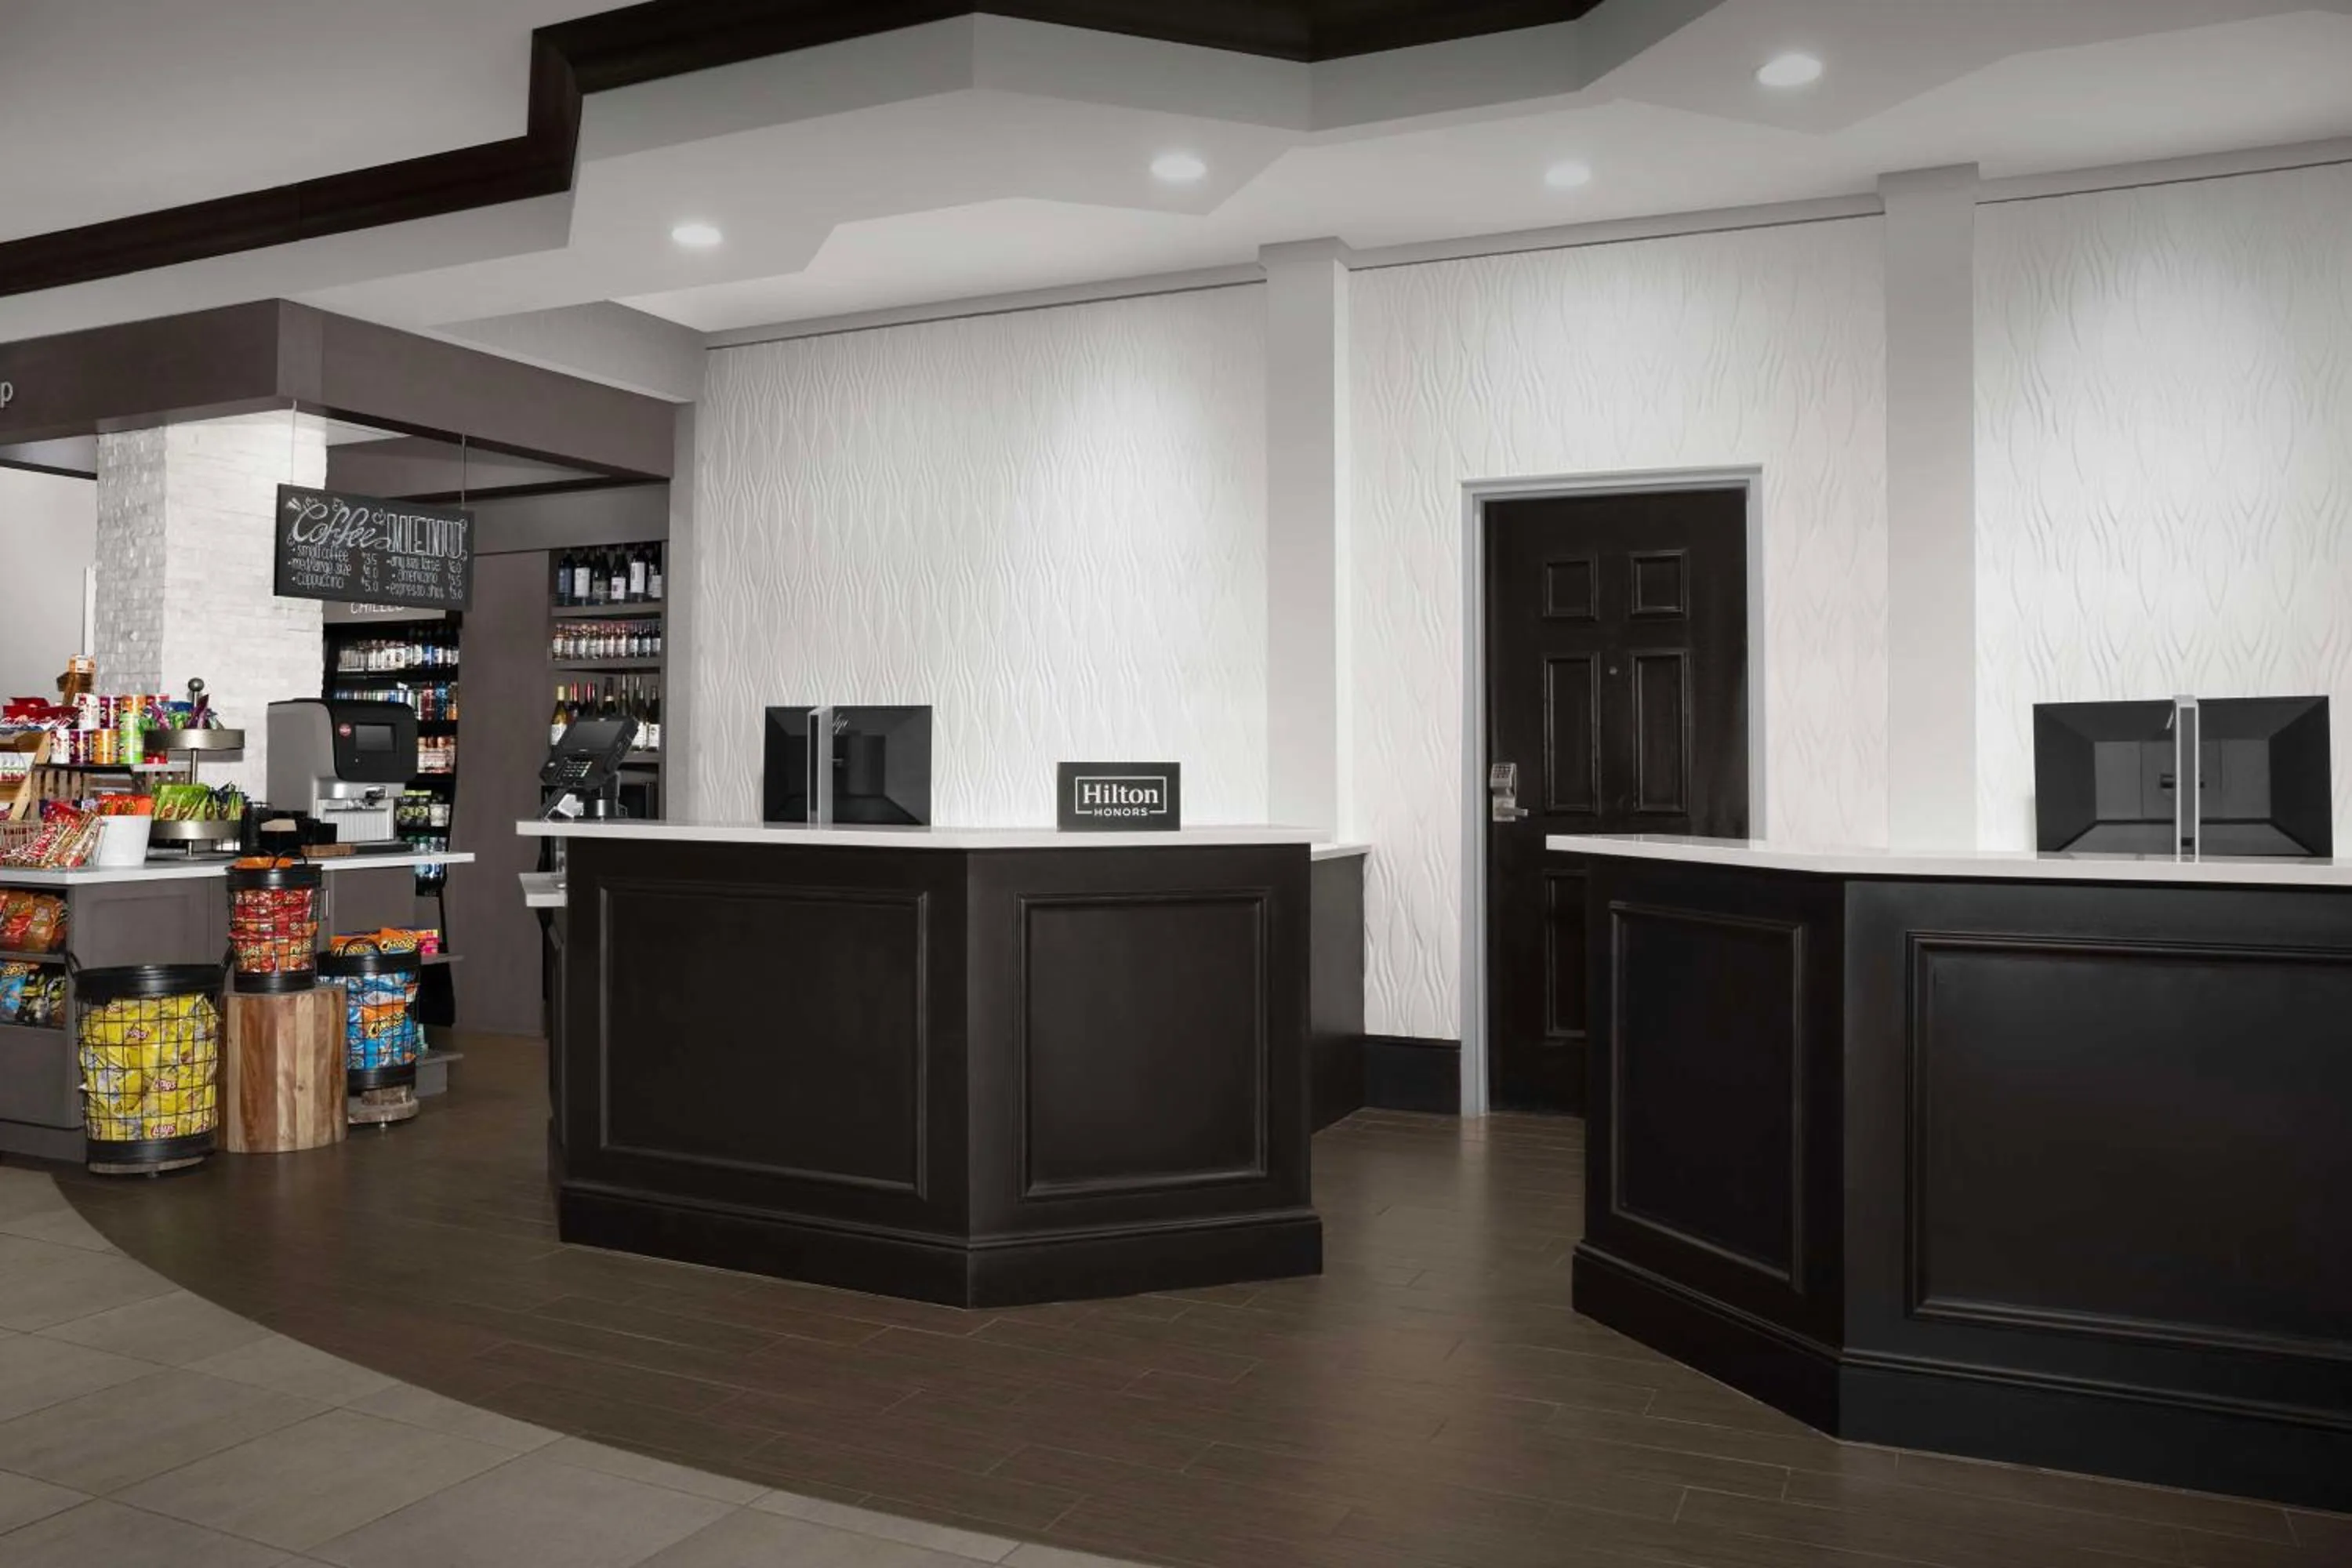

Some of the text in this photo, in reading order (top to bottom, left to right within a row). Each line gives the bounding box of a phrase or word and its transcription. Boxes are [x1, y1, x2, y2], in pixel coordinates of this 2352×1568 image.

[292, 503, 463, 559] Coffee MENU
[1083, 784, 1159, 804] Hilton
[1094, 807, 1149, 817] HONORS
